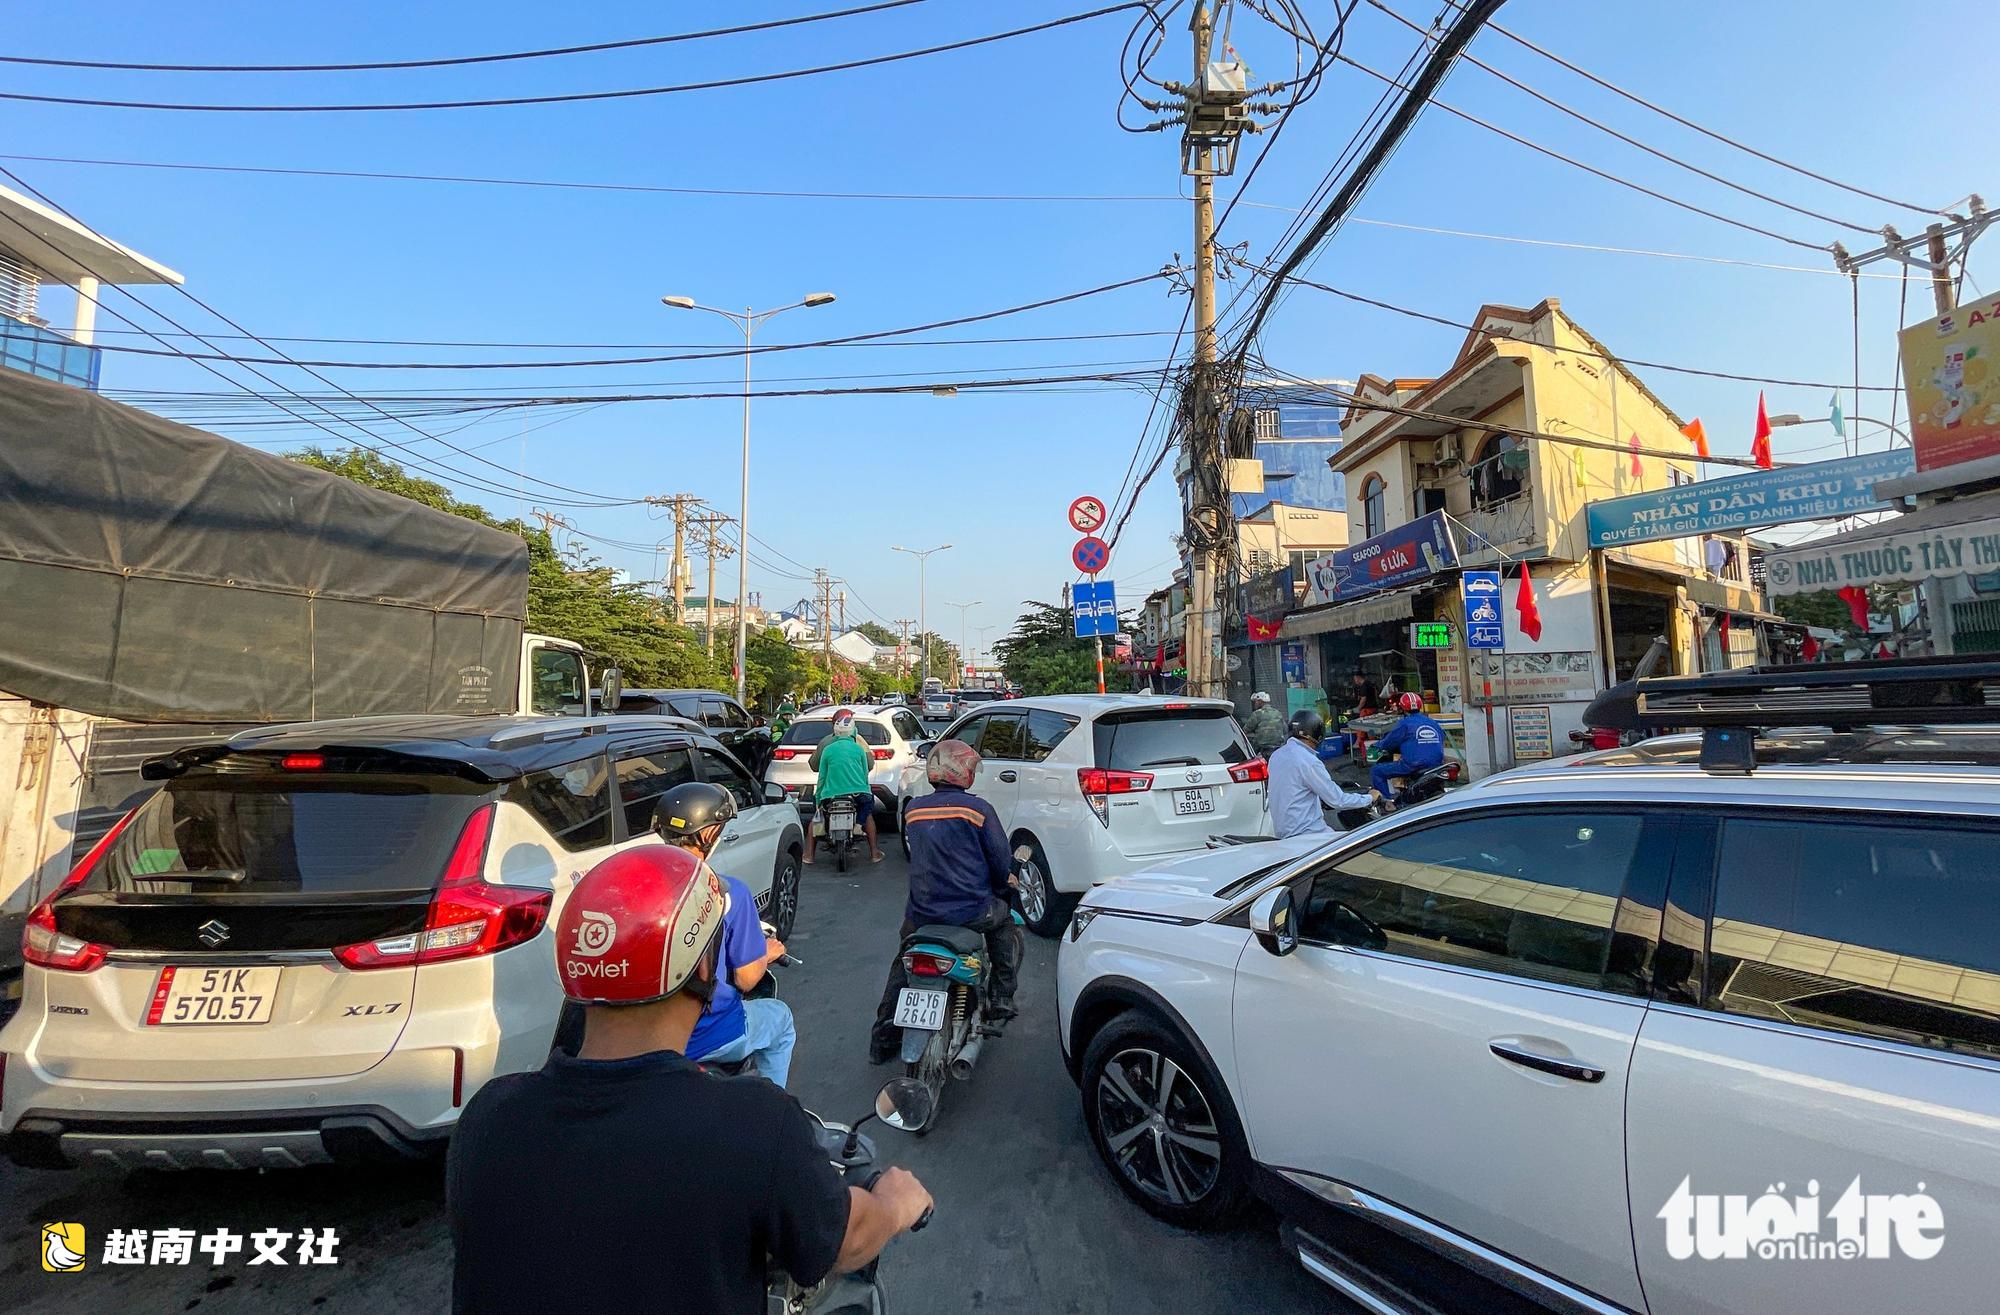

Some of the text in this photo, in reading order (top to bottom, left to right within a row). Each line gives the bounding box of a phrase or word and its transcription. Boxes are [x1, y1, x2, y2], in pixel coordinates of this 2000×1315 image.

[1675, 491, 1696, 500] BAN
[1699, 484, 1730, 497] NHÂN
[1733, 479, 1759, 490] DÂN
[1632, 502, 1699, 525] NHÂN
[1709, 492, 1766, 512] DÂN
[1776, 480, 1841, 501] KHU
[1601, 524, 1642, 541] QUYẾT
[1644, 522, 1671, 536] TÂM
[1674, 517, 1699, 531] GIỮ
[1703, 510, 1745, 528] VỮNG
[1750, 506, 1794, 522] DANH
[1799, 498, 1837, 515] HIỆU
[1352, 544, 1381, 563] SEAFOOD
[1797, 551, 1838, 586] NHÀ
[1841, 537, 1912, 579] THUỐC
[1917, 534, 1963, 572] TÂY
[1380, 558, 1388, 572] 6
[1185, 790, 1202, 800] 60A
[1180, 800, 1211, 813] 593.05
[684, 892, 714, 948] goviet
[566, 959, 630, 979] goviet
[201, 969, 250, 994] 51K
[174, 996, 263, 1021] 570.57
[343, 1002, 402, 1017] XL7
[905, 991, 940, 1009] 60-Y6
[901, 1008, 937, 1026] 2640
